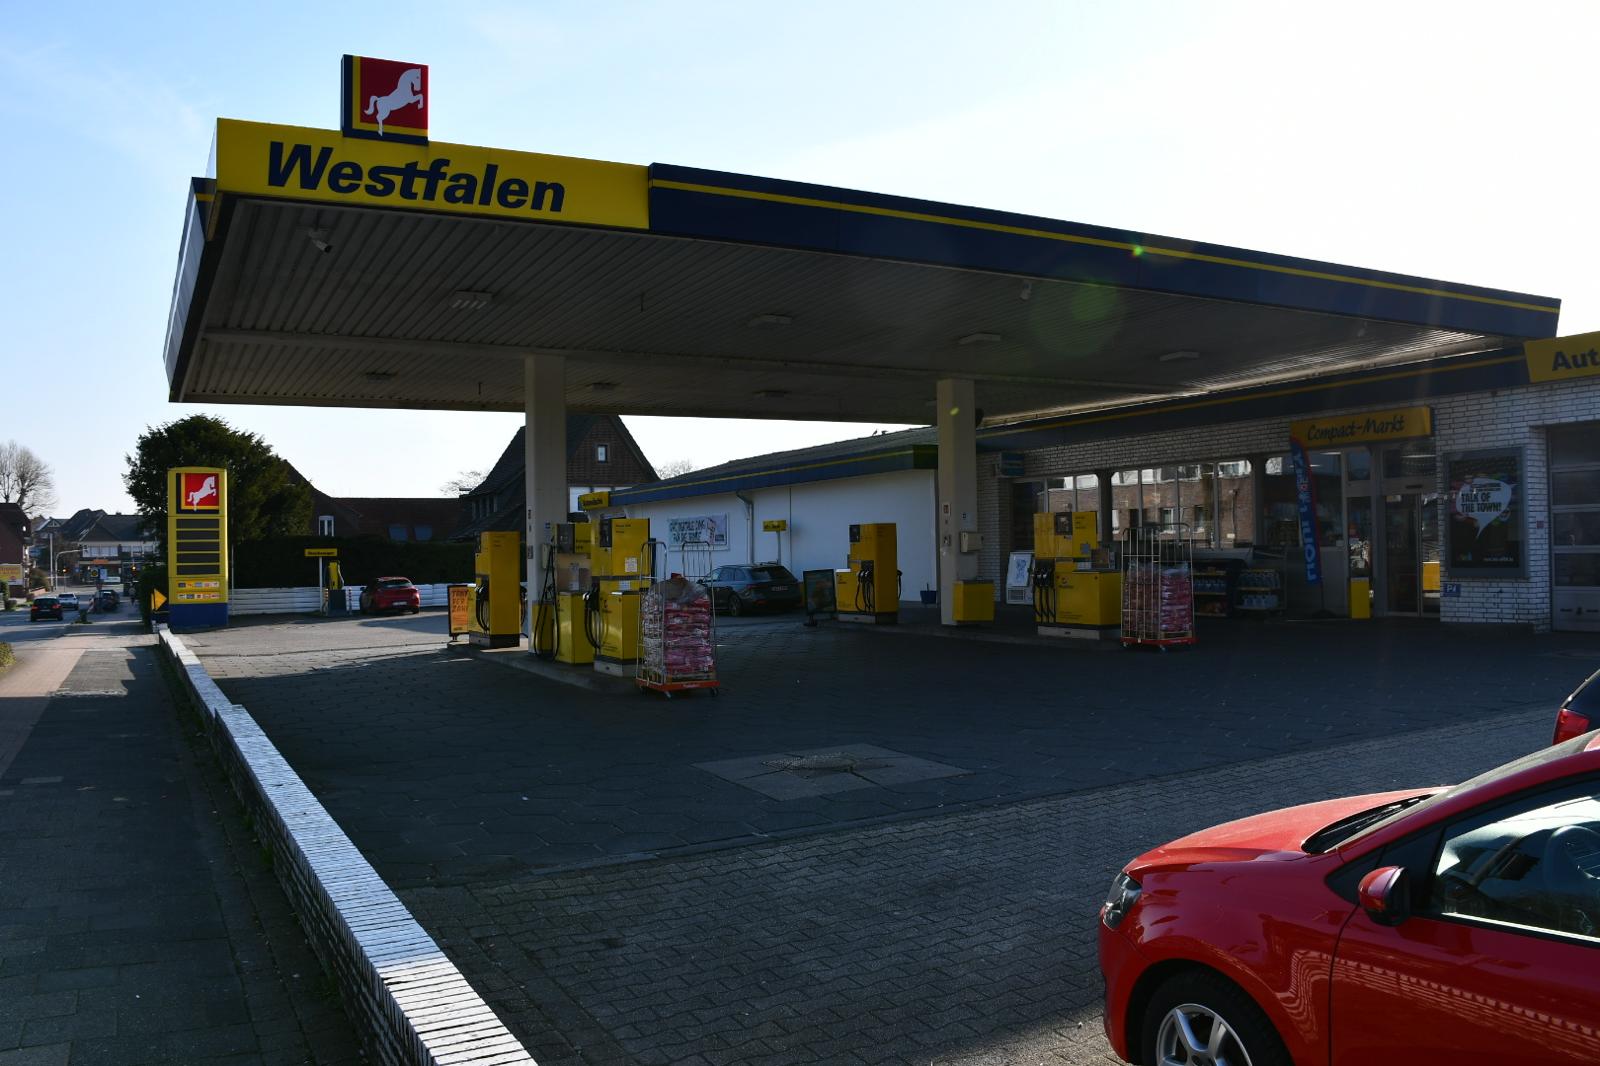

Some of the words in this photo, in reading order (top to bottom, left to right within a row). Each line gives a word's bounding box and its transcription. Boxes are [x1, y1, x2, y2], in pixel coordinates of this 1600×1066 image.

[267, 141, 566, 213] Westfalen
[1307, 415, 1405, 441] Compact-Markt
[1461, 492, 1479, 503] TALK
[1480, 492, 1491, 502] OF
[1461, 502, 1475, 513] THE
